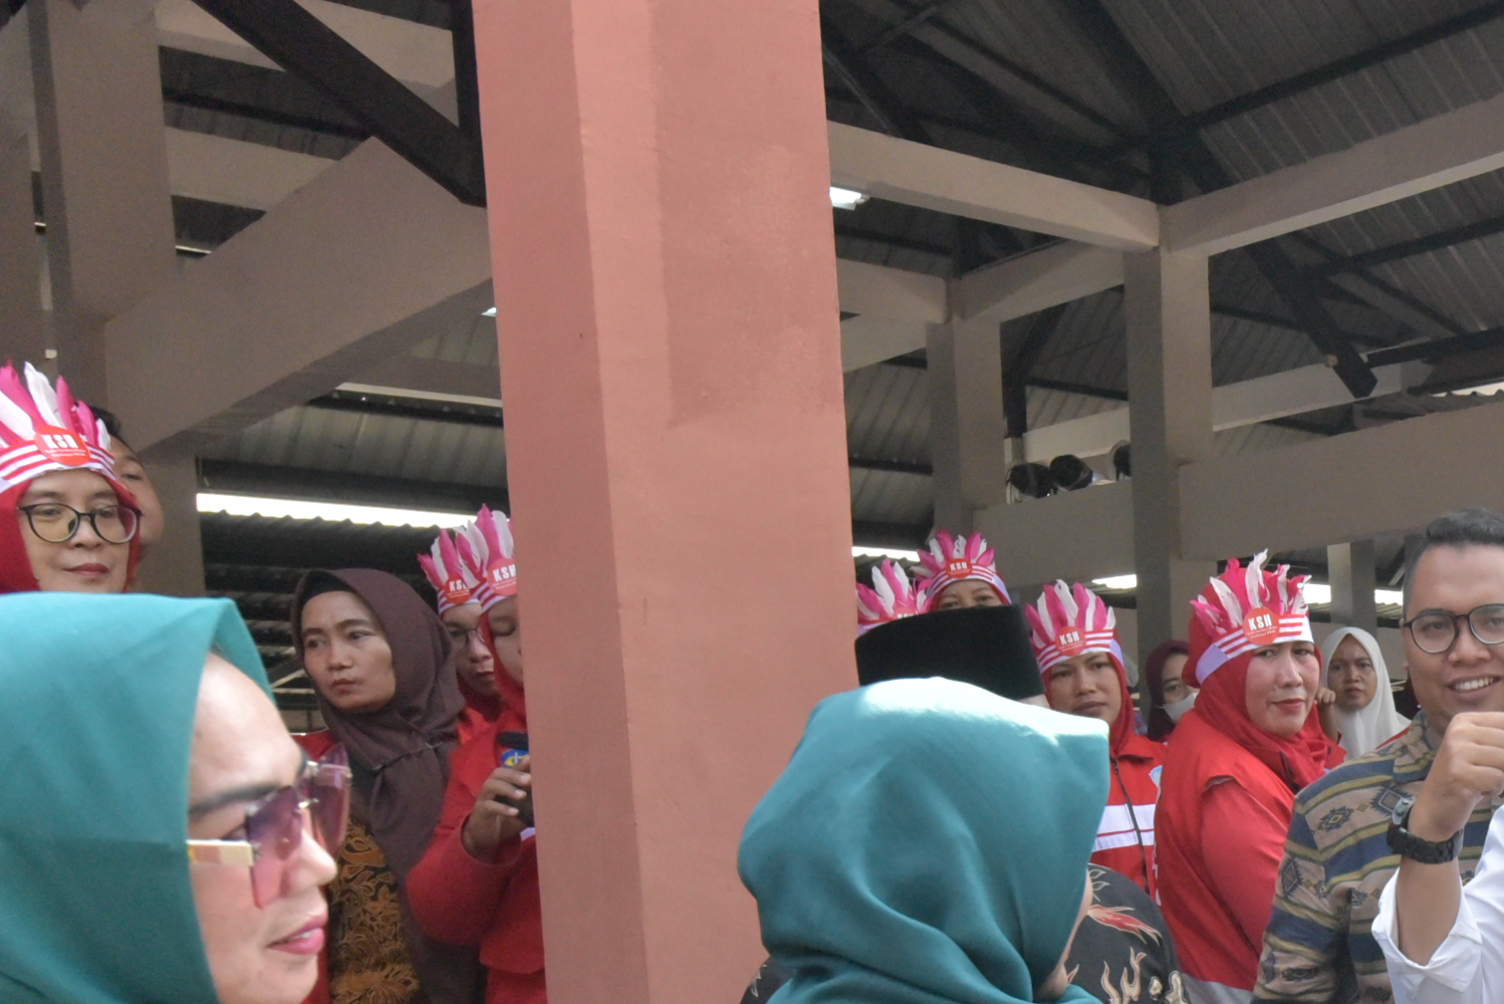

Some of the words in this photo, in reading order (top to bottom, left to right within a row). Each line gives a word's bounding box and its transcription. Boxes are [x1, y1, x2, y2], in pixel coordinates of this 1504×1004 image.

[41, 434, 80, 449] KSH
[950, 561, 968, 571] KSH
[1248, 613, 1272, 630] KSH
[1060, 631, 1080, 645] KSH
